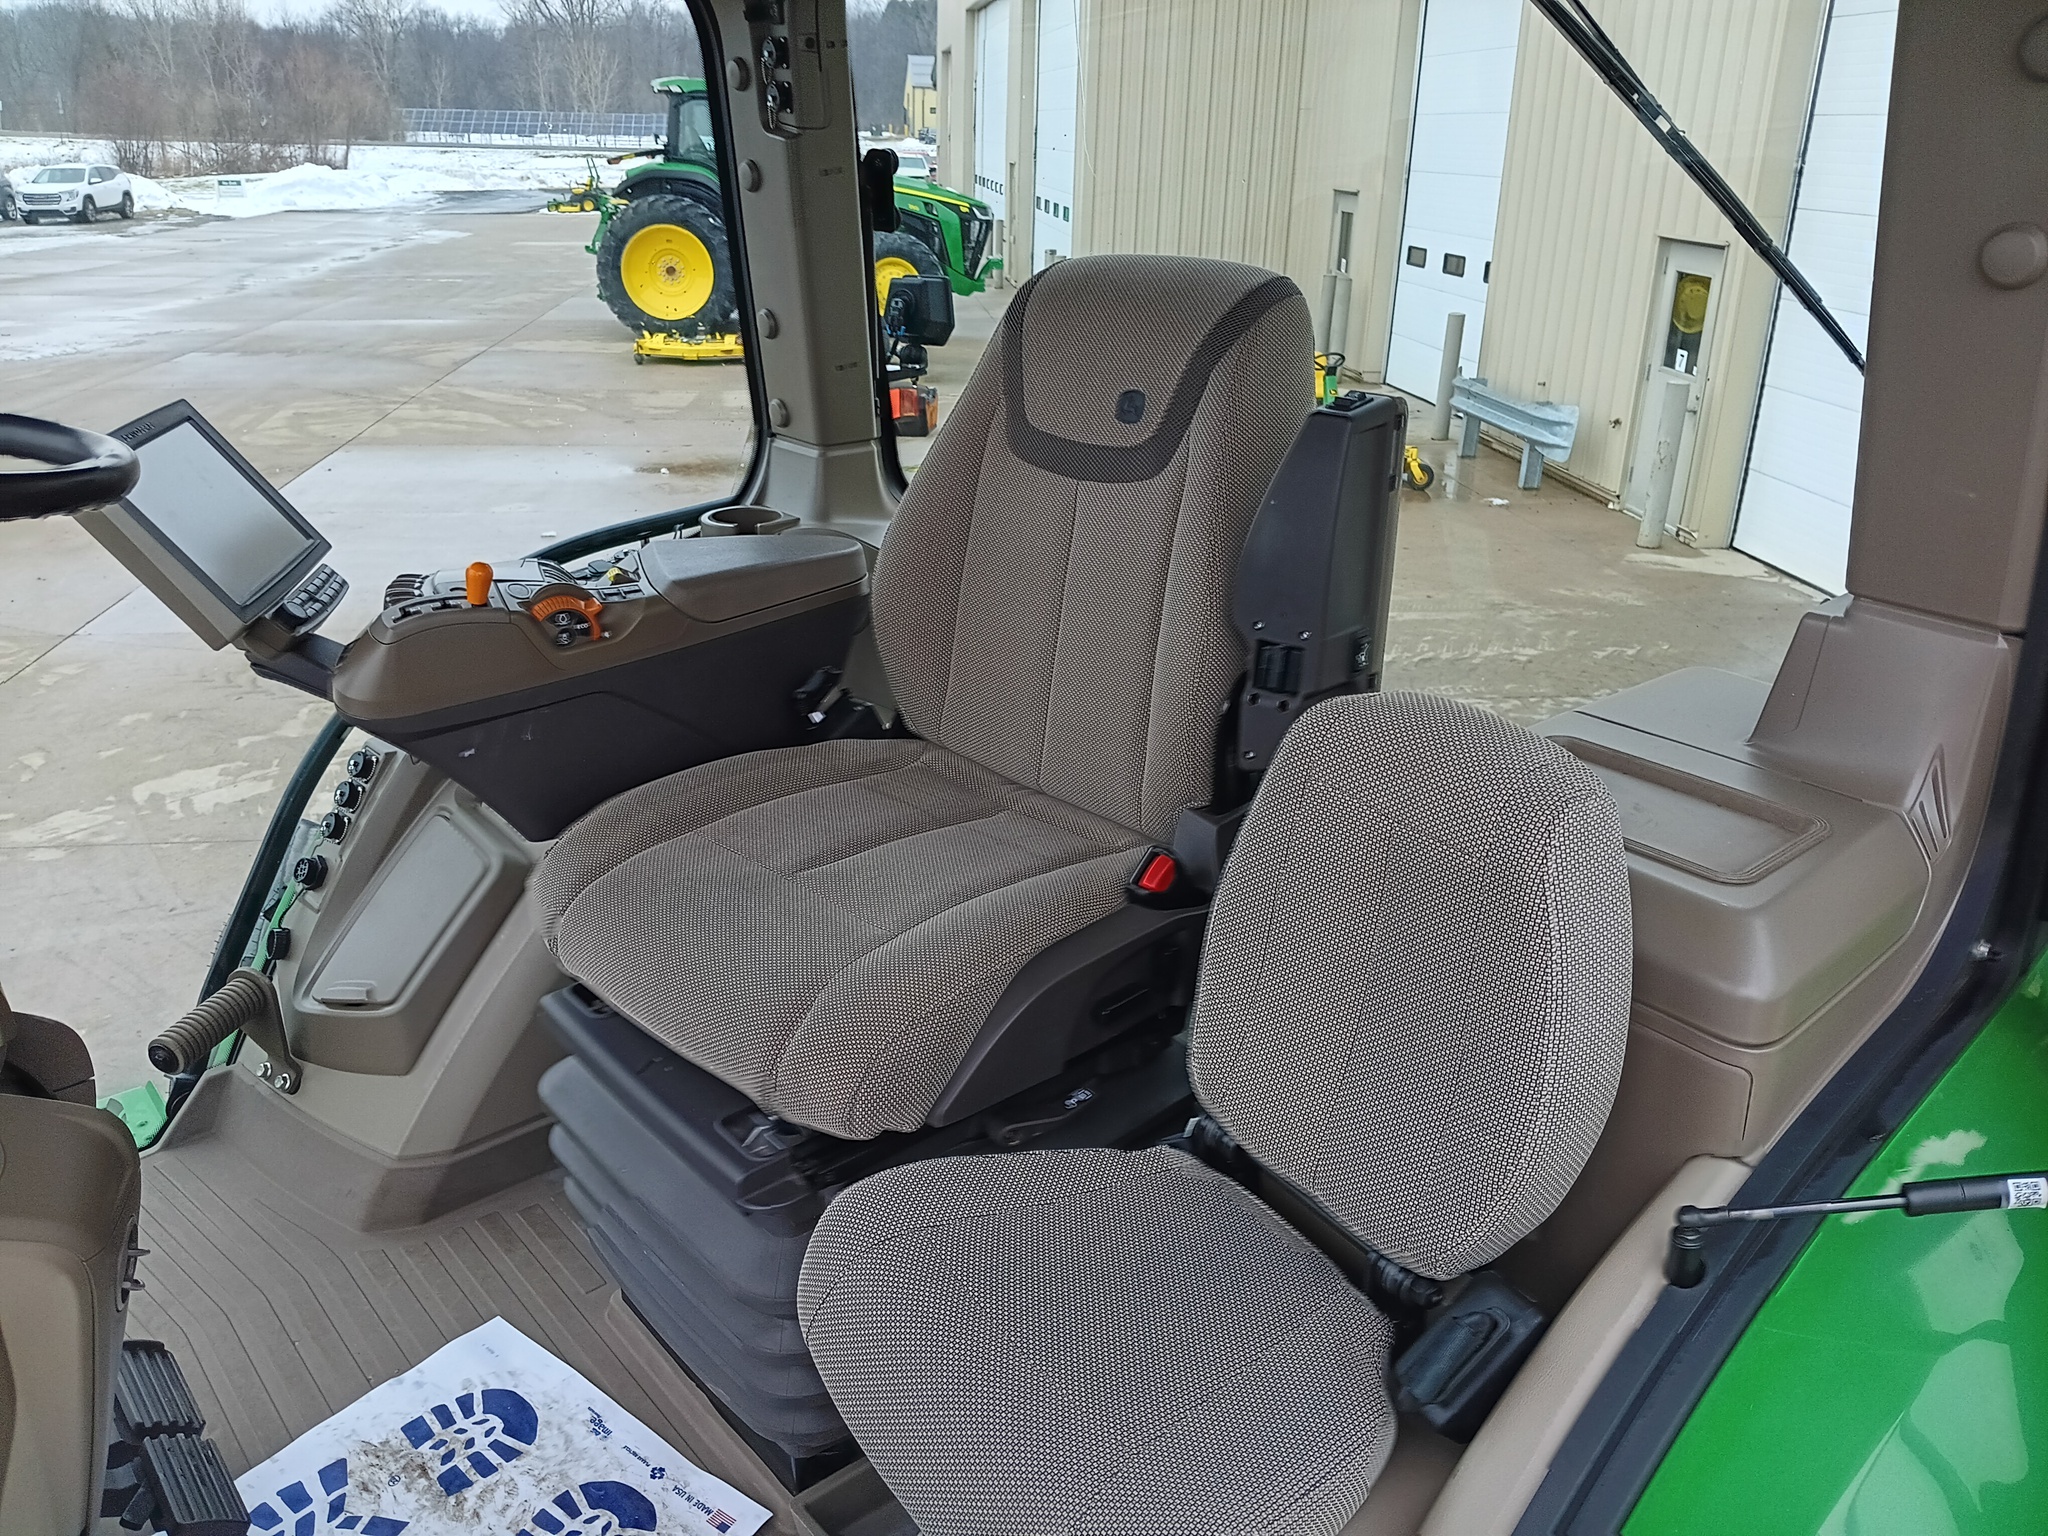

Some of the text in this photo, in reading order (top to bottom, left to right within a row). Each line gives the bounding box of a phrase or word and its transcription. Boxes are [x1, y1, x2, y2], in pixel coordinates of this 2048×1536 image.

[672, 1484, 714, 1516] MADE IN USA
